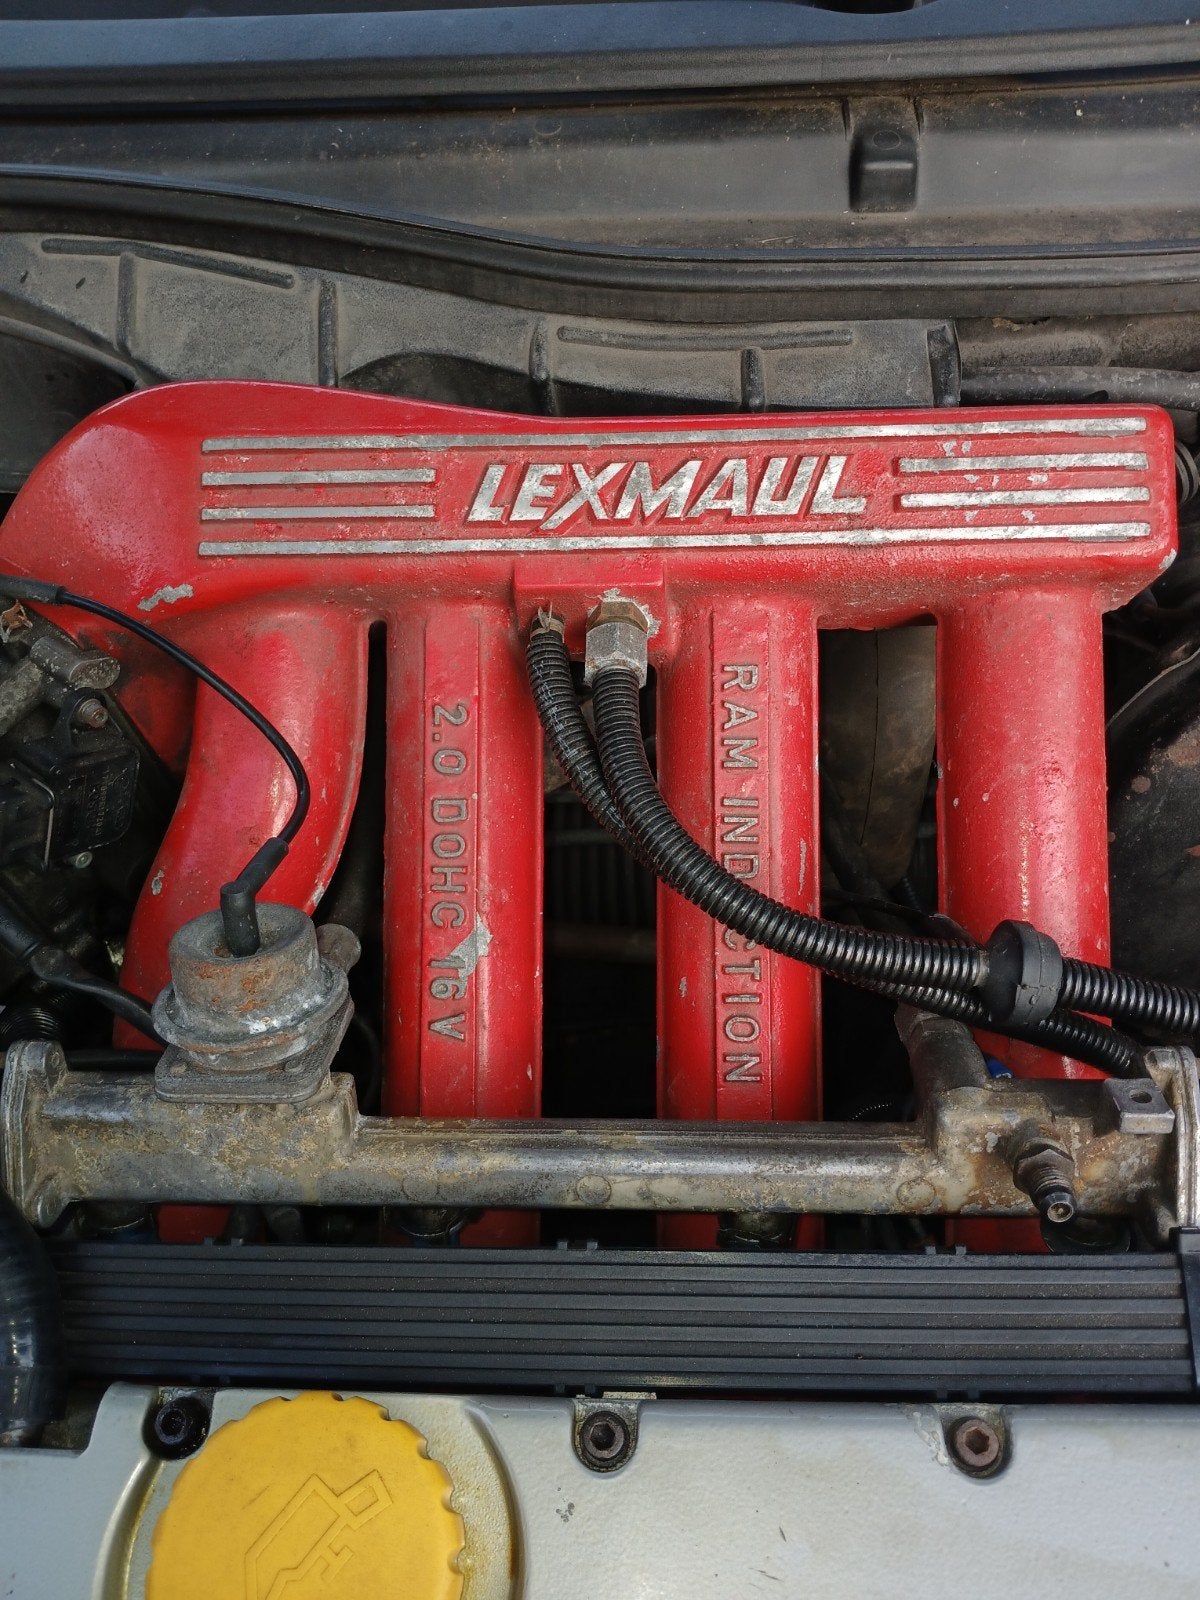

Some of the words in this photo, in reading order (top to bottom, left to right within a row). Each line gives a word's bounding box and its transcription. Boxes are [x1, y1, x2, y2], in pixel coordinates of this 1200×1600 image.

[466, 455, 868, 531] LEXMAUL
[431, 704, 468, 776] 2.0
[721, 664, 759, 769] RAM
[431, 797, 469, 928] DOHC
[721, 797, 761, 1083] INDCTION
